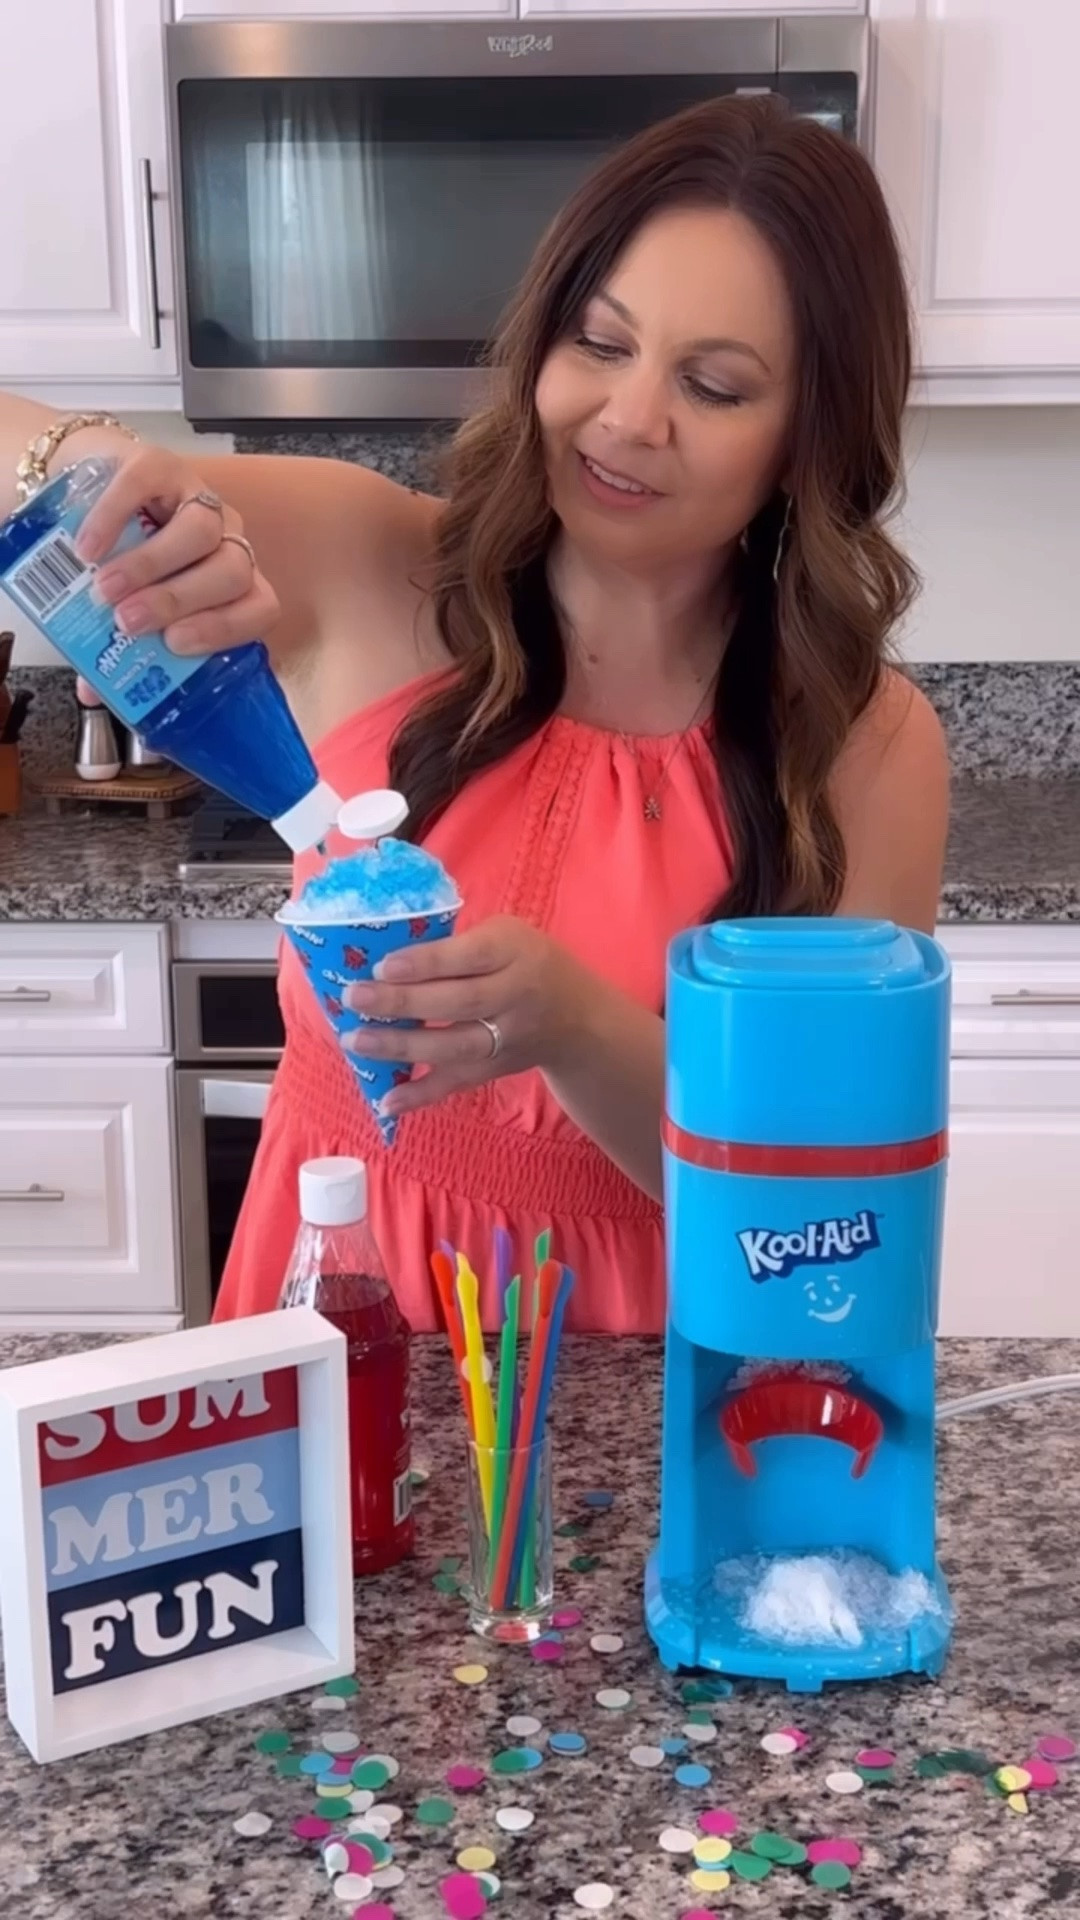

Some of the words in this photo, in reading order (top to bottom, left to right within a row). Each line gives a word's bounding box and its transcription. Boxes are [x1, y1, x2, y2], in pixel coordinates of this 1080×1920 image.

[737, 1211, 873, 1277] Kool-Aid
[45, 1373, 271, 1460] SUM
[49, 1463, 274, 1576] MER
[62, 1560, 278, 1680] FUN
